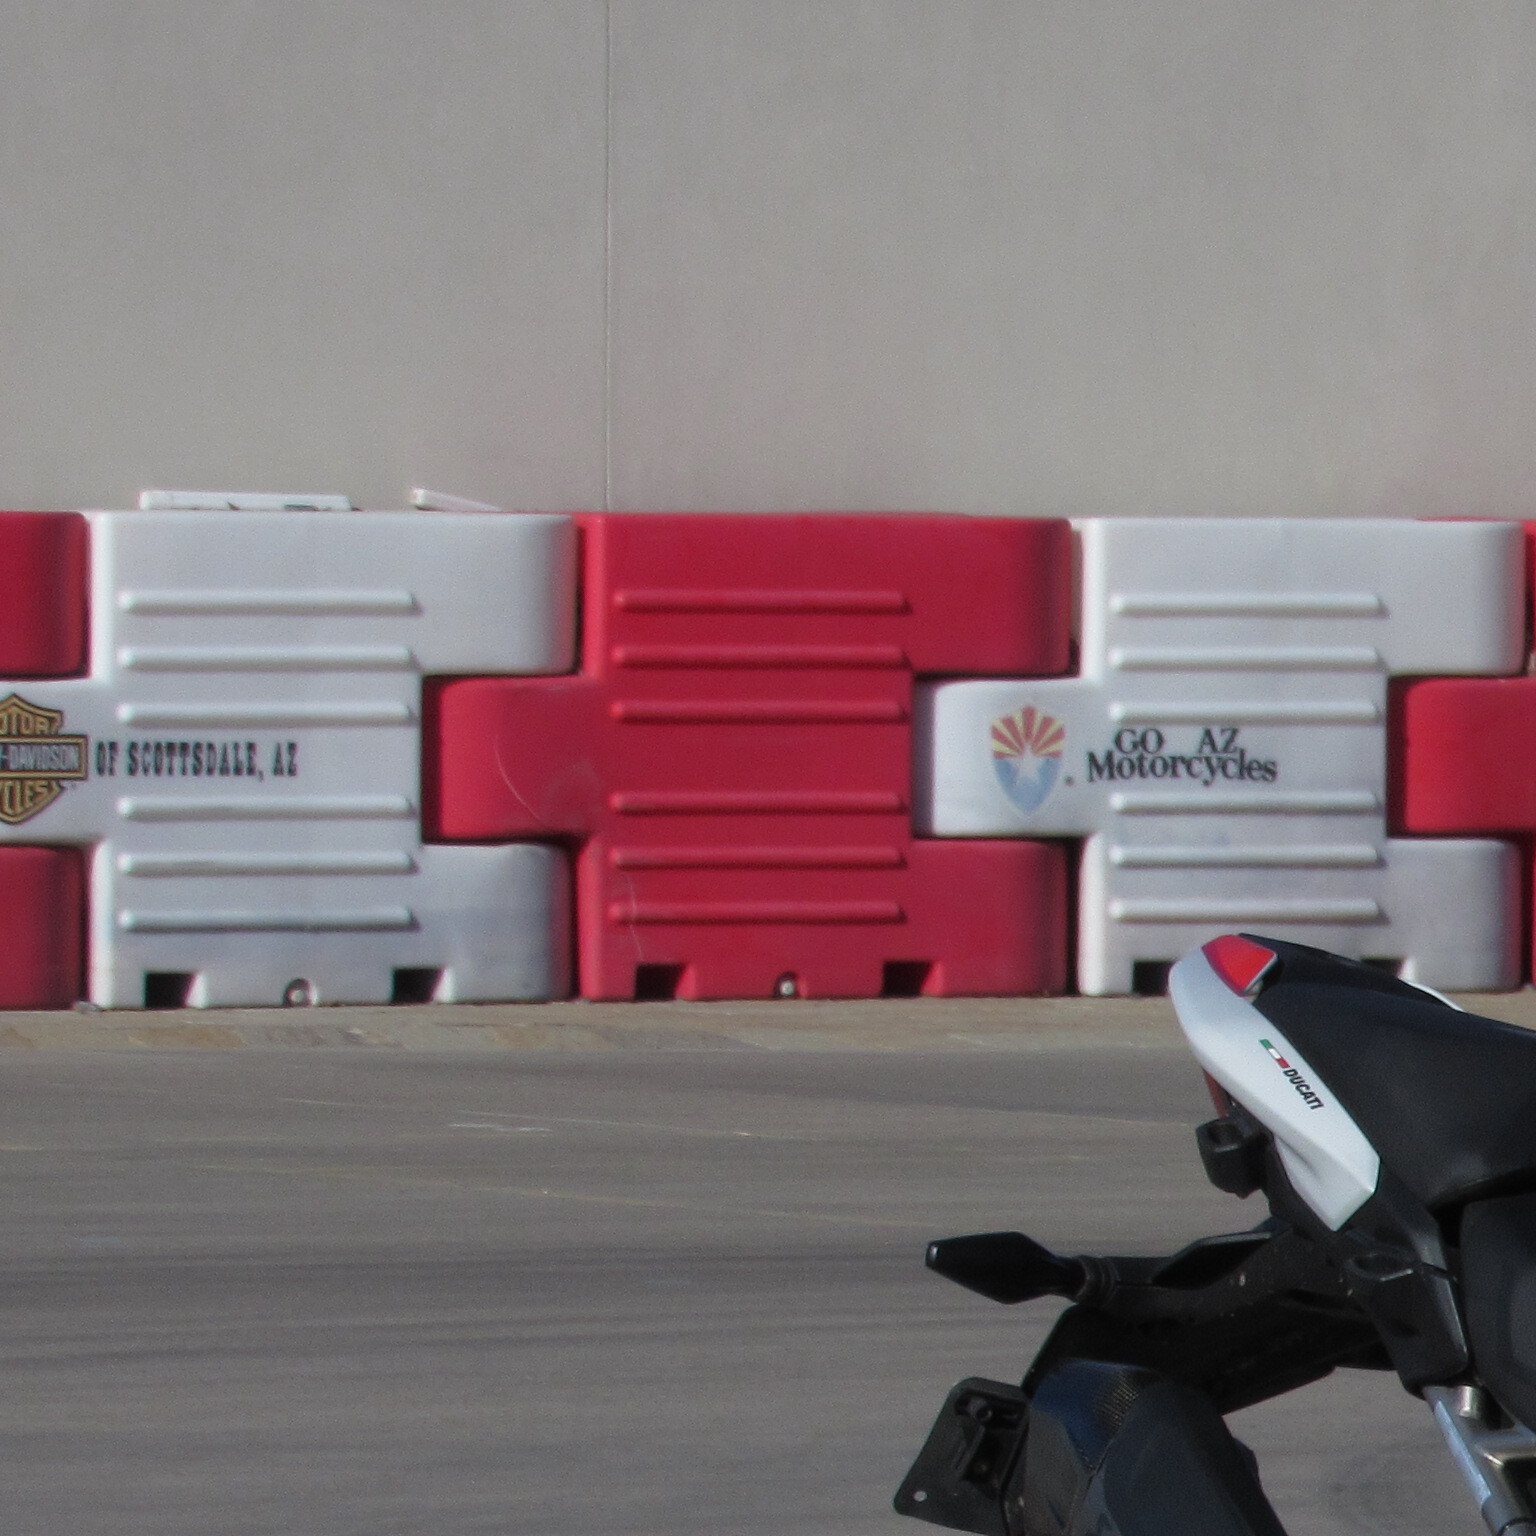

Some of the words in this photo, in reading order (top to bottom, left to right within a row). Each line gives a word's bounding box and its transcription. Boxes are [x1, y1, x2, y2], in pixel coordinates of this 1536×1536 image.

[1114, 728, 1165, 754] GO
[1198, 727, 1240, 754] AZ
[95, 741, 119, 776] OF
[126, 741, 265, 782] SCOTTSDALE,
[273, 741, 298, 777] AZ
[1086, 749, 1278, 786] Motorcycles
[1282, 1068, 1325, 1111] DUCATI
